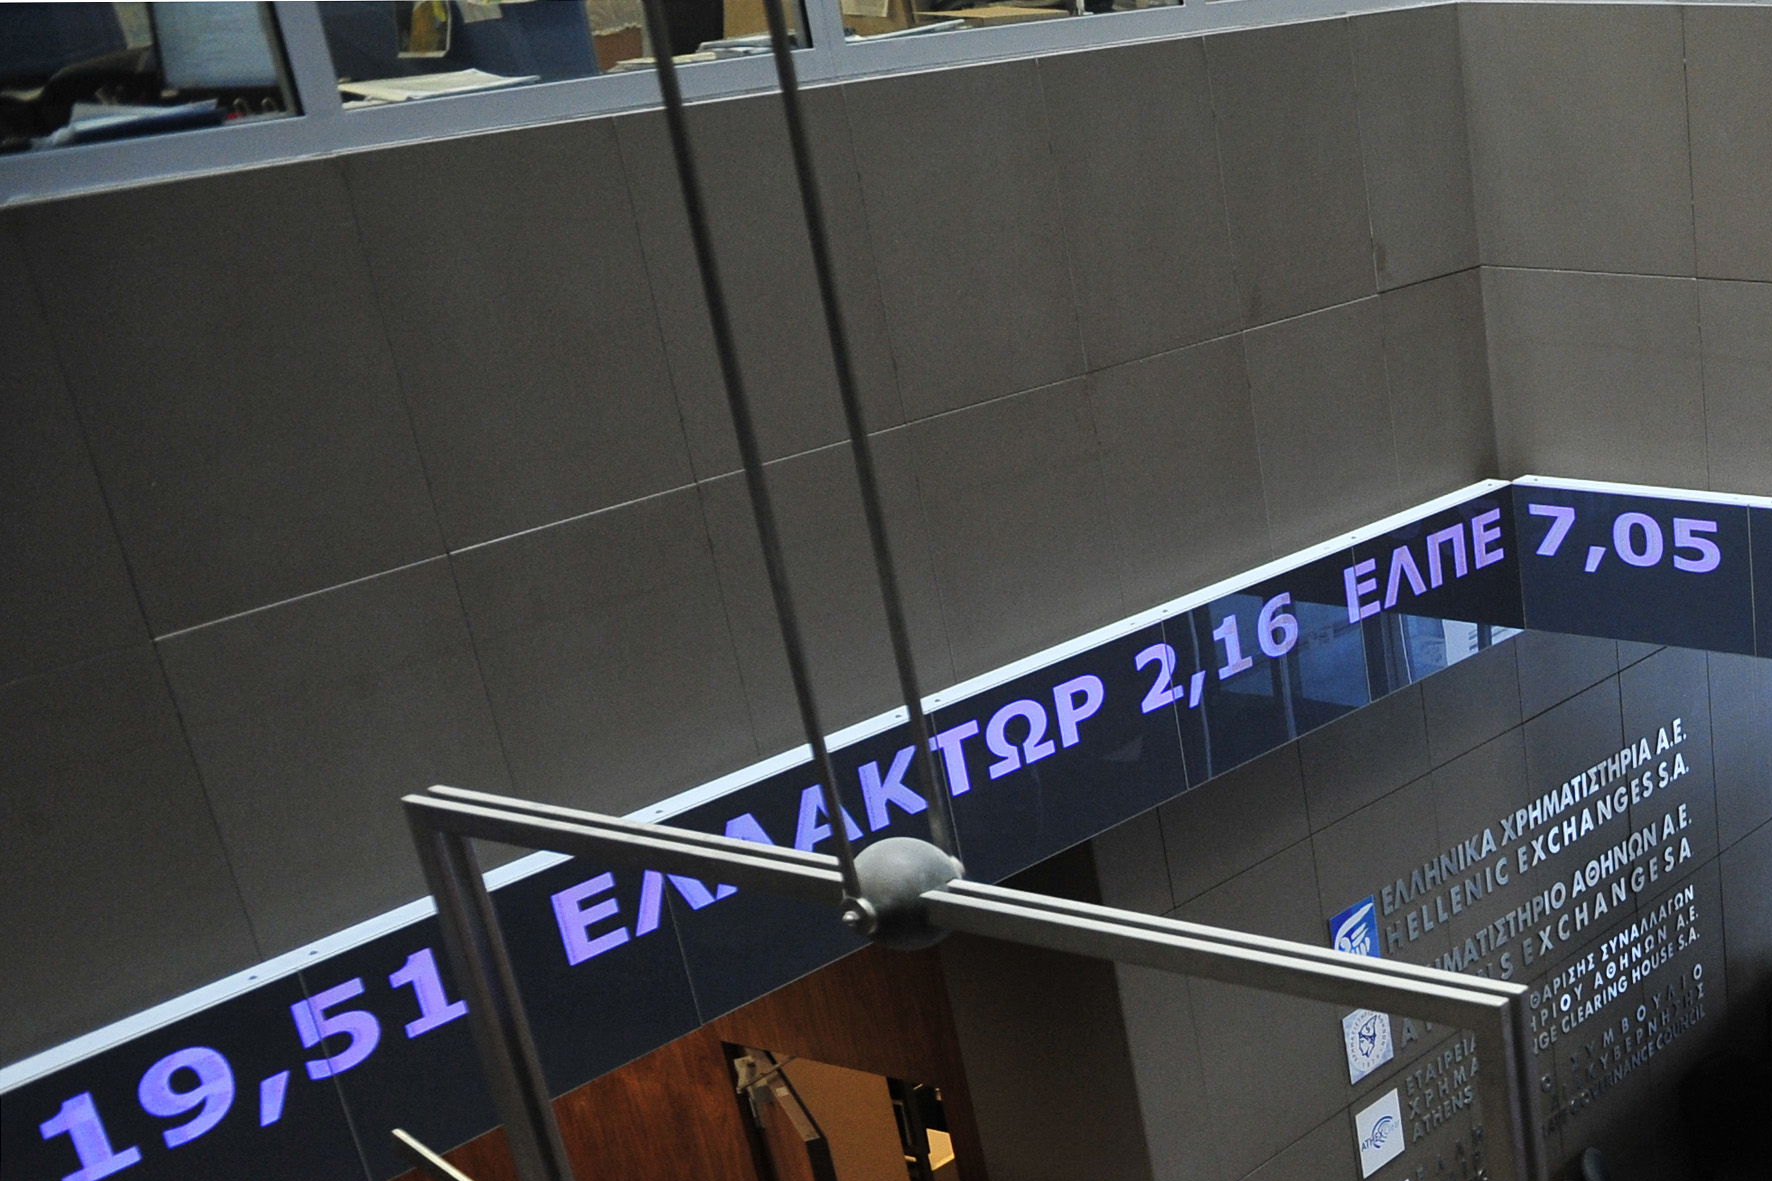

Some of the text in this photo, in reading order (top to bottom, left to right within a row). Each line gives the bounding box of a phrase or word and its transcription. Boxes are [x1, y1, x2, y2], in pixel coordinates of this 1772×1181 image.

[1135, 591, 1300, 715] 2,16
[1343, 507, 1506, 625] ΕΛΠΕ
[1528, 503, 1722, 573] 7,05
[1381, 828, 1498, 916] ΕΛΛΗΝΙΚΑ
[1499, 737, 1652, 846] ΧΡΗΜΑΤΙΣΤΗΡΙΑ
[1385, 752, 1690, 953] HELLENIC EXCHANGES S.A.
[1434, 881, 1567, 972] ΜΑΤΙΣΤΗΡΙΟ
[1571, 822, 1658, 898] ΑΘΗΝΩΝ
[1523, 856, 1659, 966] EXCHANGE
[1529, 952, 1596, 1010] ΘΑΡΙΣΗΣ
[1600, 884, 1695, 962] ΣΥΝΑΛΛΑΓΩΝ
[1594, 925, 1668, 990] ΑΘΗΝΩΝ
[1412, 927, 1701, 1143] ATHENS CLEARING HOUSE S.A.
